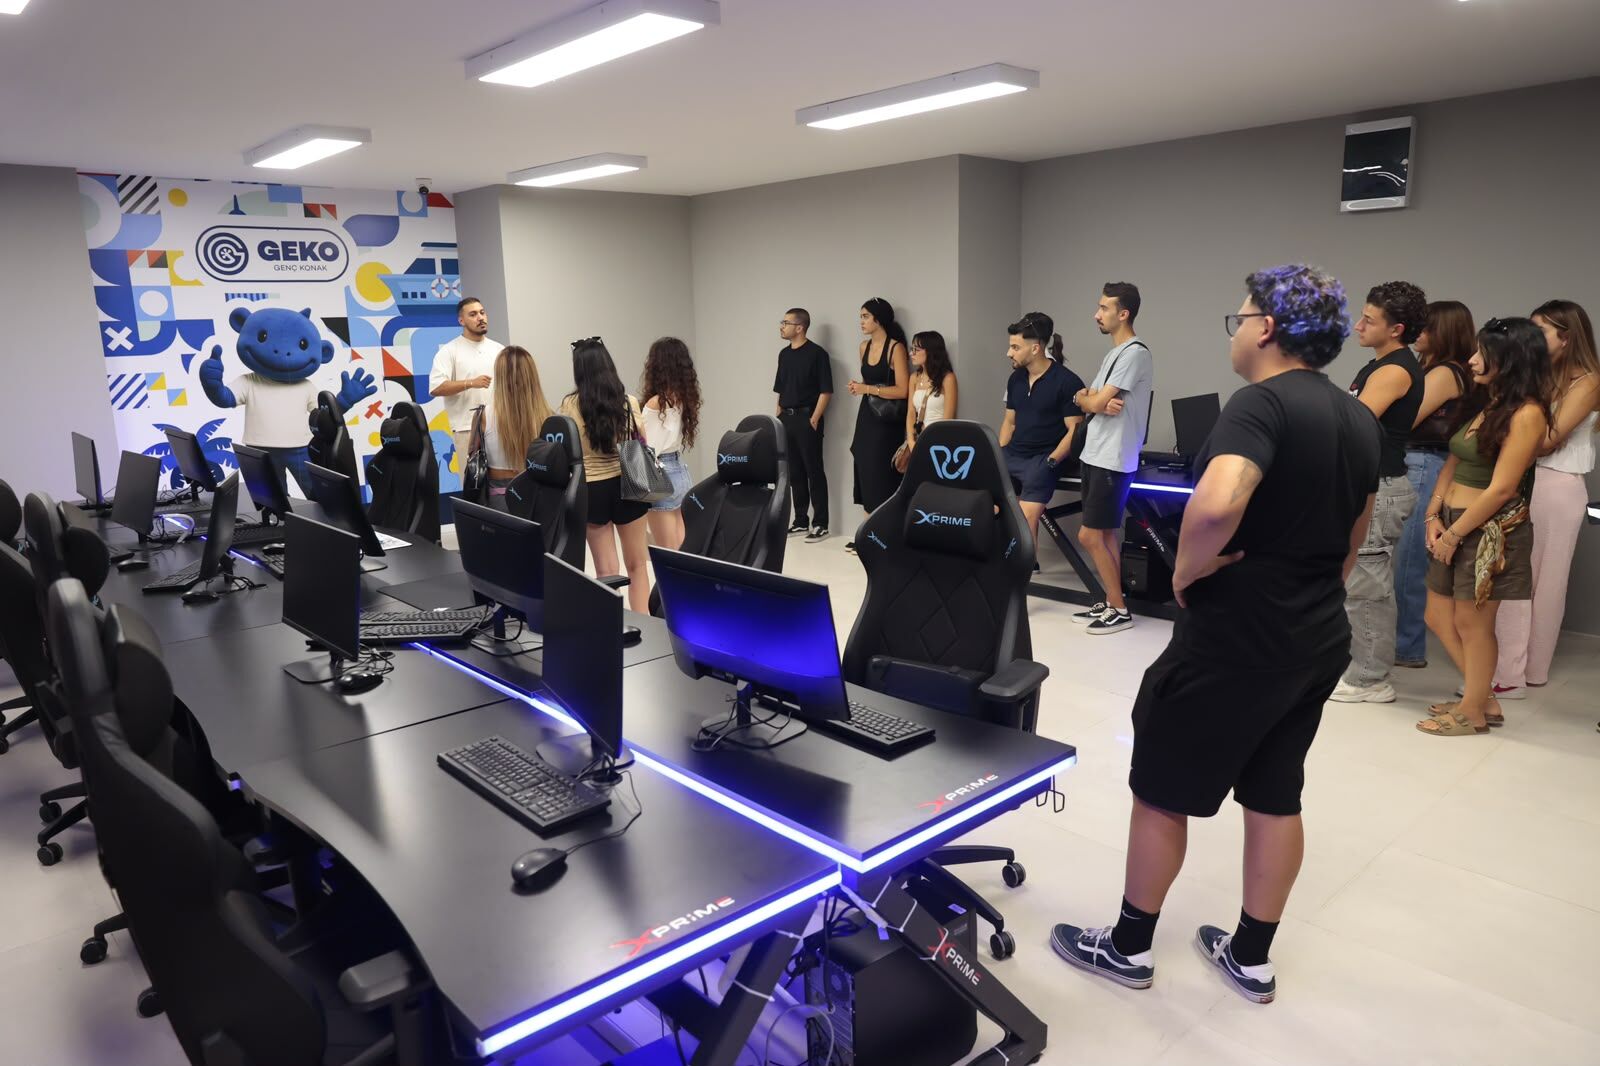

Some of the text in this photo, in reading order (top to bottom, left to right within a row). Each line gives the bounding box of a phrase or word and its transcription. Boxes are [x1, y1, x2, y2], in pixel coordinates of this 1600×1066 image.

[257, 240, 340, 262] GEKO
[274, 264, 298, 272] GENÇ
[718, 453, 748, 465] XPRIME
[914, 509, 972, 526] XPRIME
